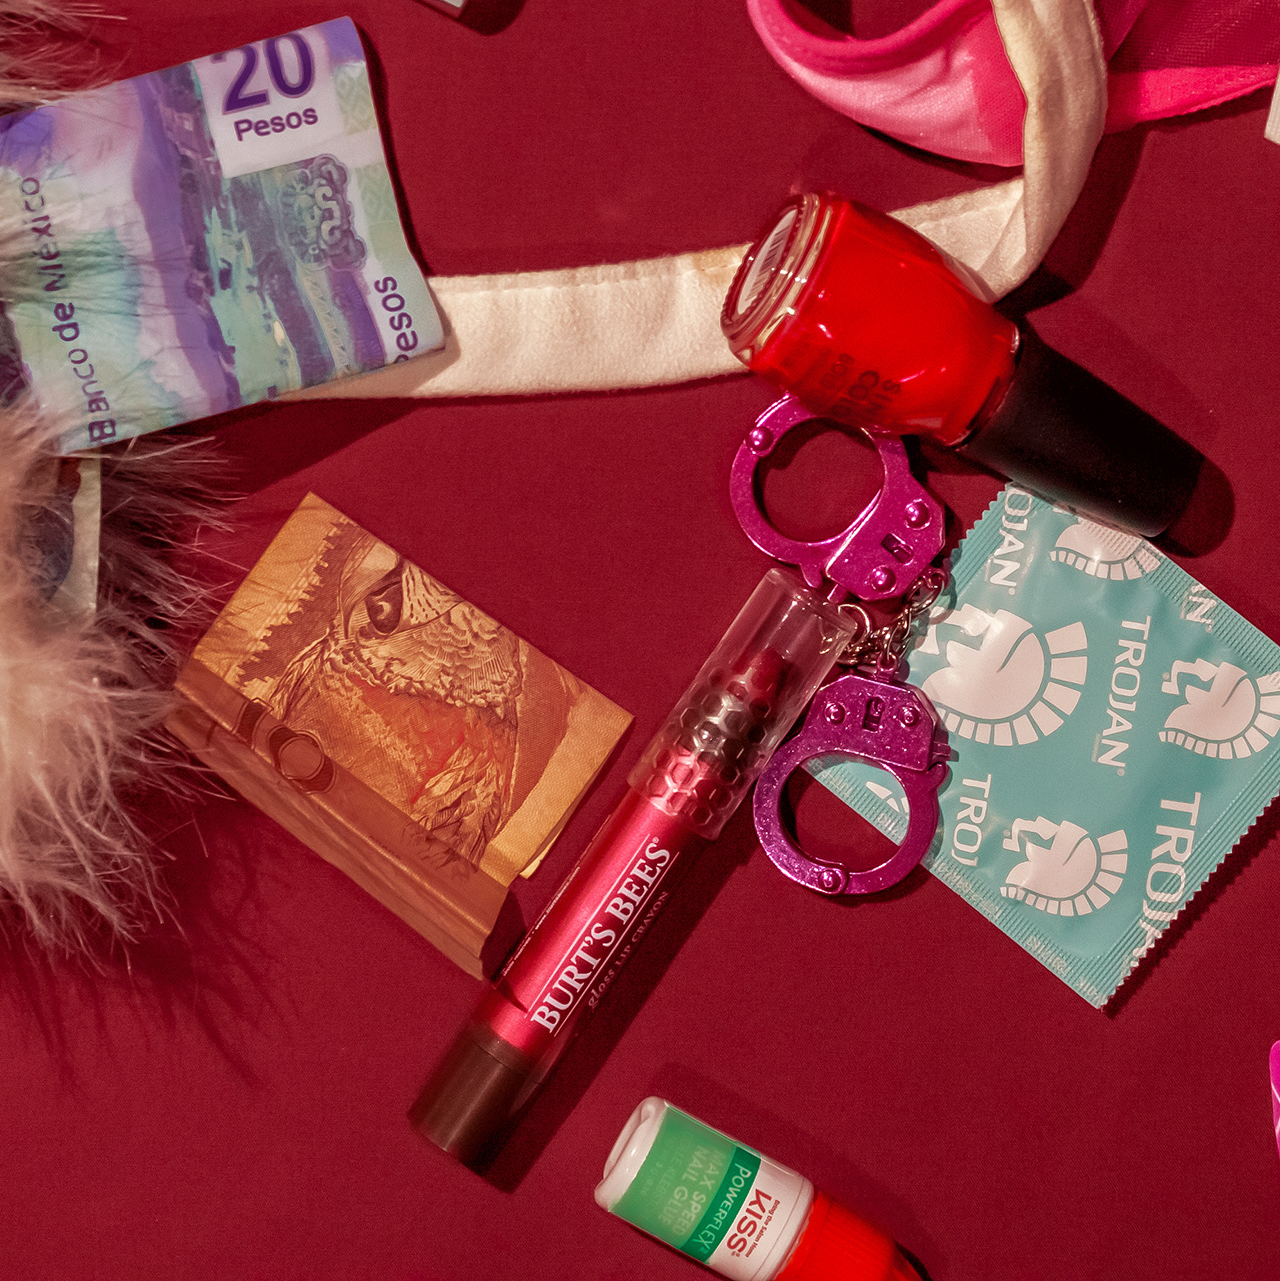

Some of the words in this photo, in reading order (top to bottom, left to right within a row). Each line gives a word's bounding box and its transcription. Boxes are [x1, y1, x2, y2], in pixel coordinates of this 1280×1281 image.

[210, 33, 317, 116] 20
[233, 107, 319, 142] Pesos
[52, 302, 80, 343] de
[68, 348, 117, 445] Banco
[1097, 615, 1151, 768] TROJAN
[601, 838, 674, 925] BEES
[583, 966, 619, 1009] gloss
[614, 943, 633, 966] LIP
[628, 889, 672, 944] CRAYON
[680, 1144, 710, 1184] NAIL
[656, 1182, 690, 1228] GLUE
[670, 1188, 707, 1238] SPEED
[691, 1161, 752, 1250] POWERFLEX
[724, 1187, 772, 1256] KISS
[763, 1215, 772, 1226] the
[767, 1198, 780, 1216] Bring
[744, 1241, 758, 1259] Home
[754, 1225, 767, 1243] Salon
